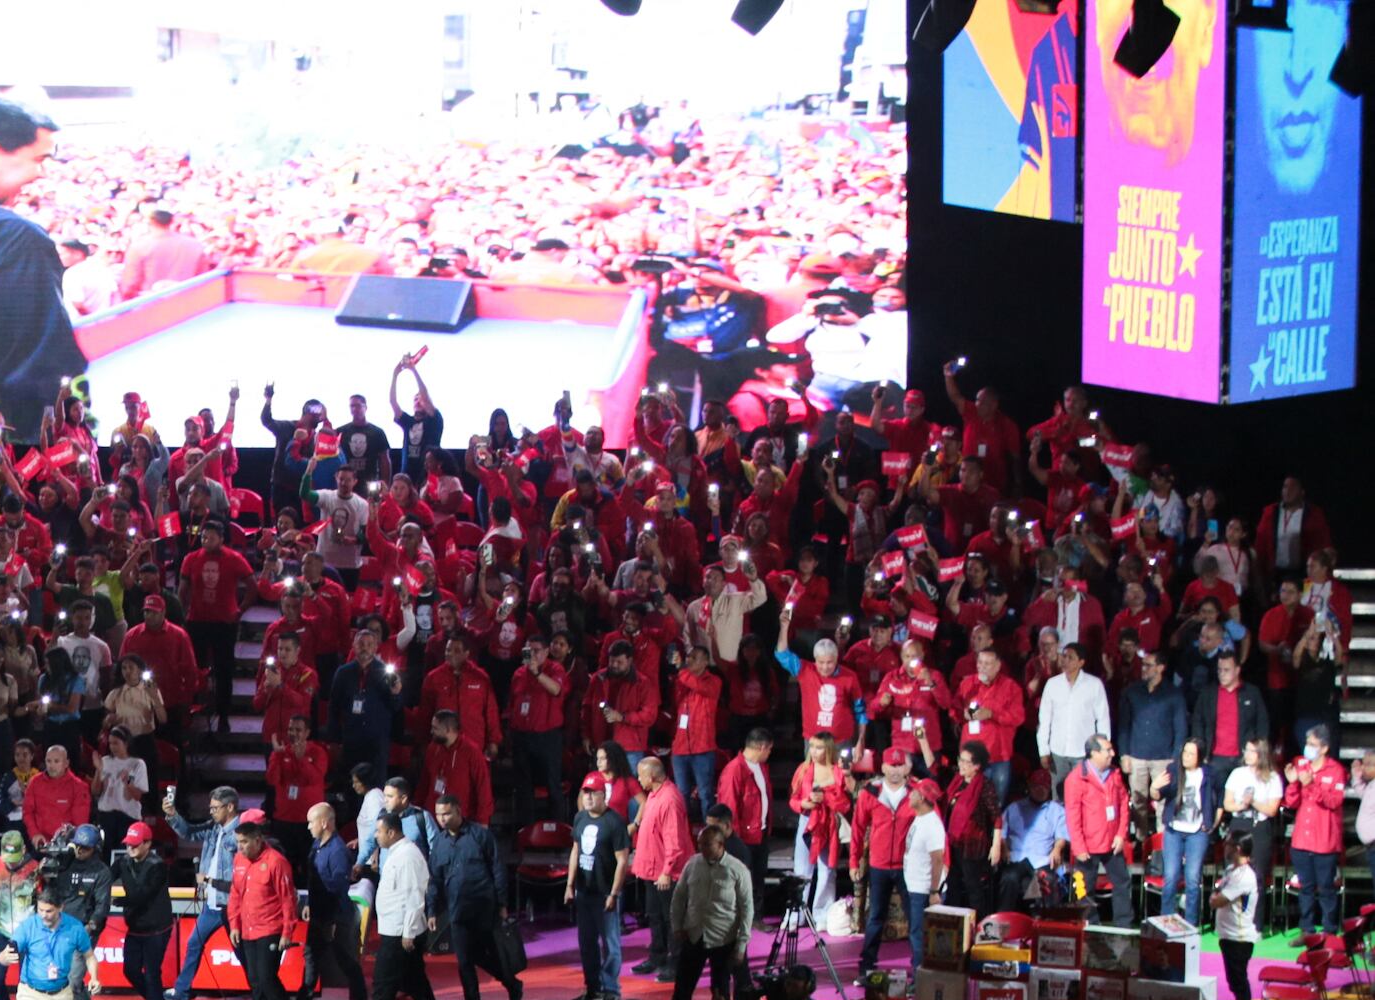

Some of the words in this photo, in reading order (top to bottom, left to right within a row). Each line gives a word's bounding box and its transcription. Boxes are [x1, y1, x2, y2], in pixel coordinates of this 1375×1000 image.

[1117, 185, 1181, 230] SIEMPRE
[1268, 216, 1339, 260] ESPERANZA
[1108, 225, 1177, 287] JUNTO
[1109, 287, 1195, 353] PUEBLO
[1256, 259, 1304, 326] ESTÁ
[1307, 264, 1334, 319] EN
[1272, 326, 1330, 386] CALLE
